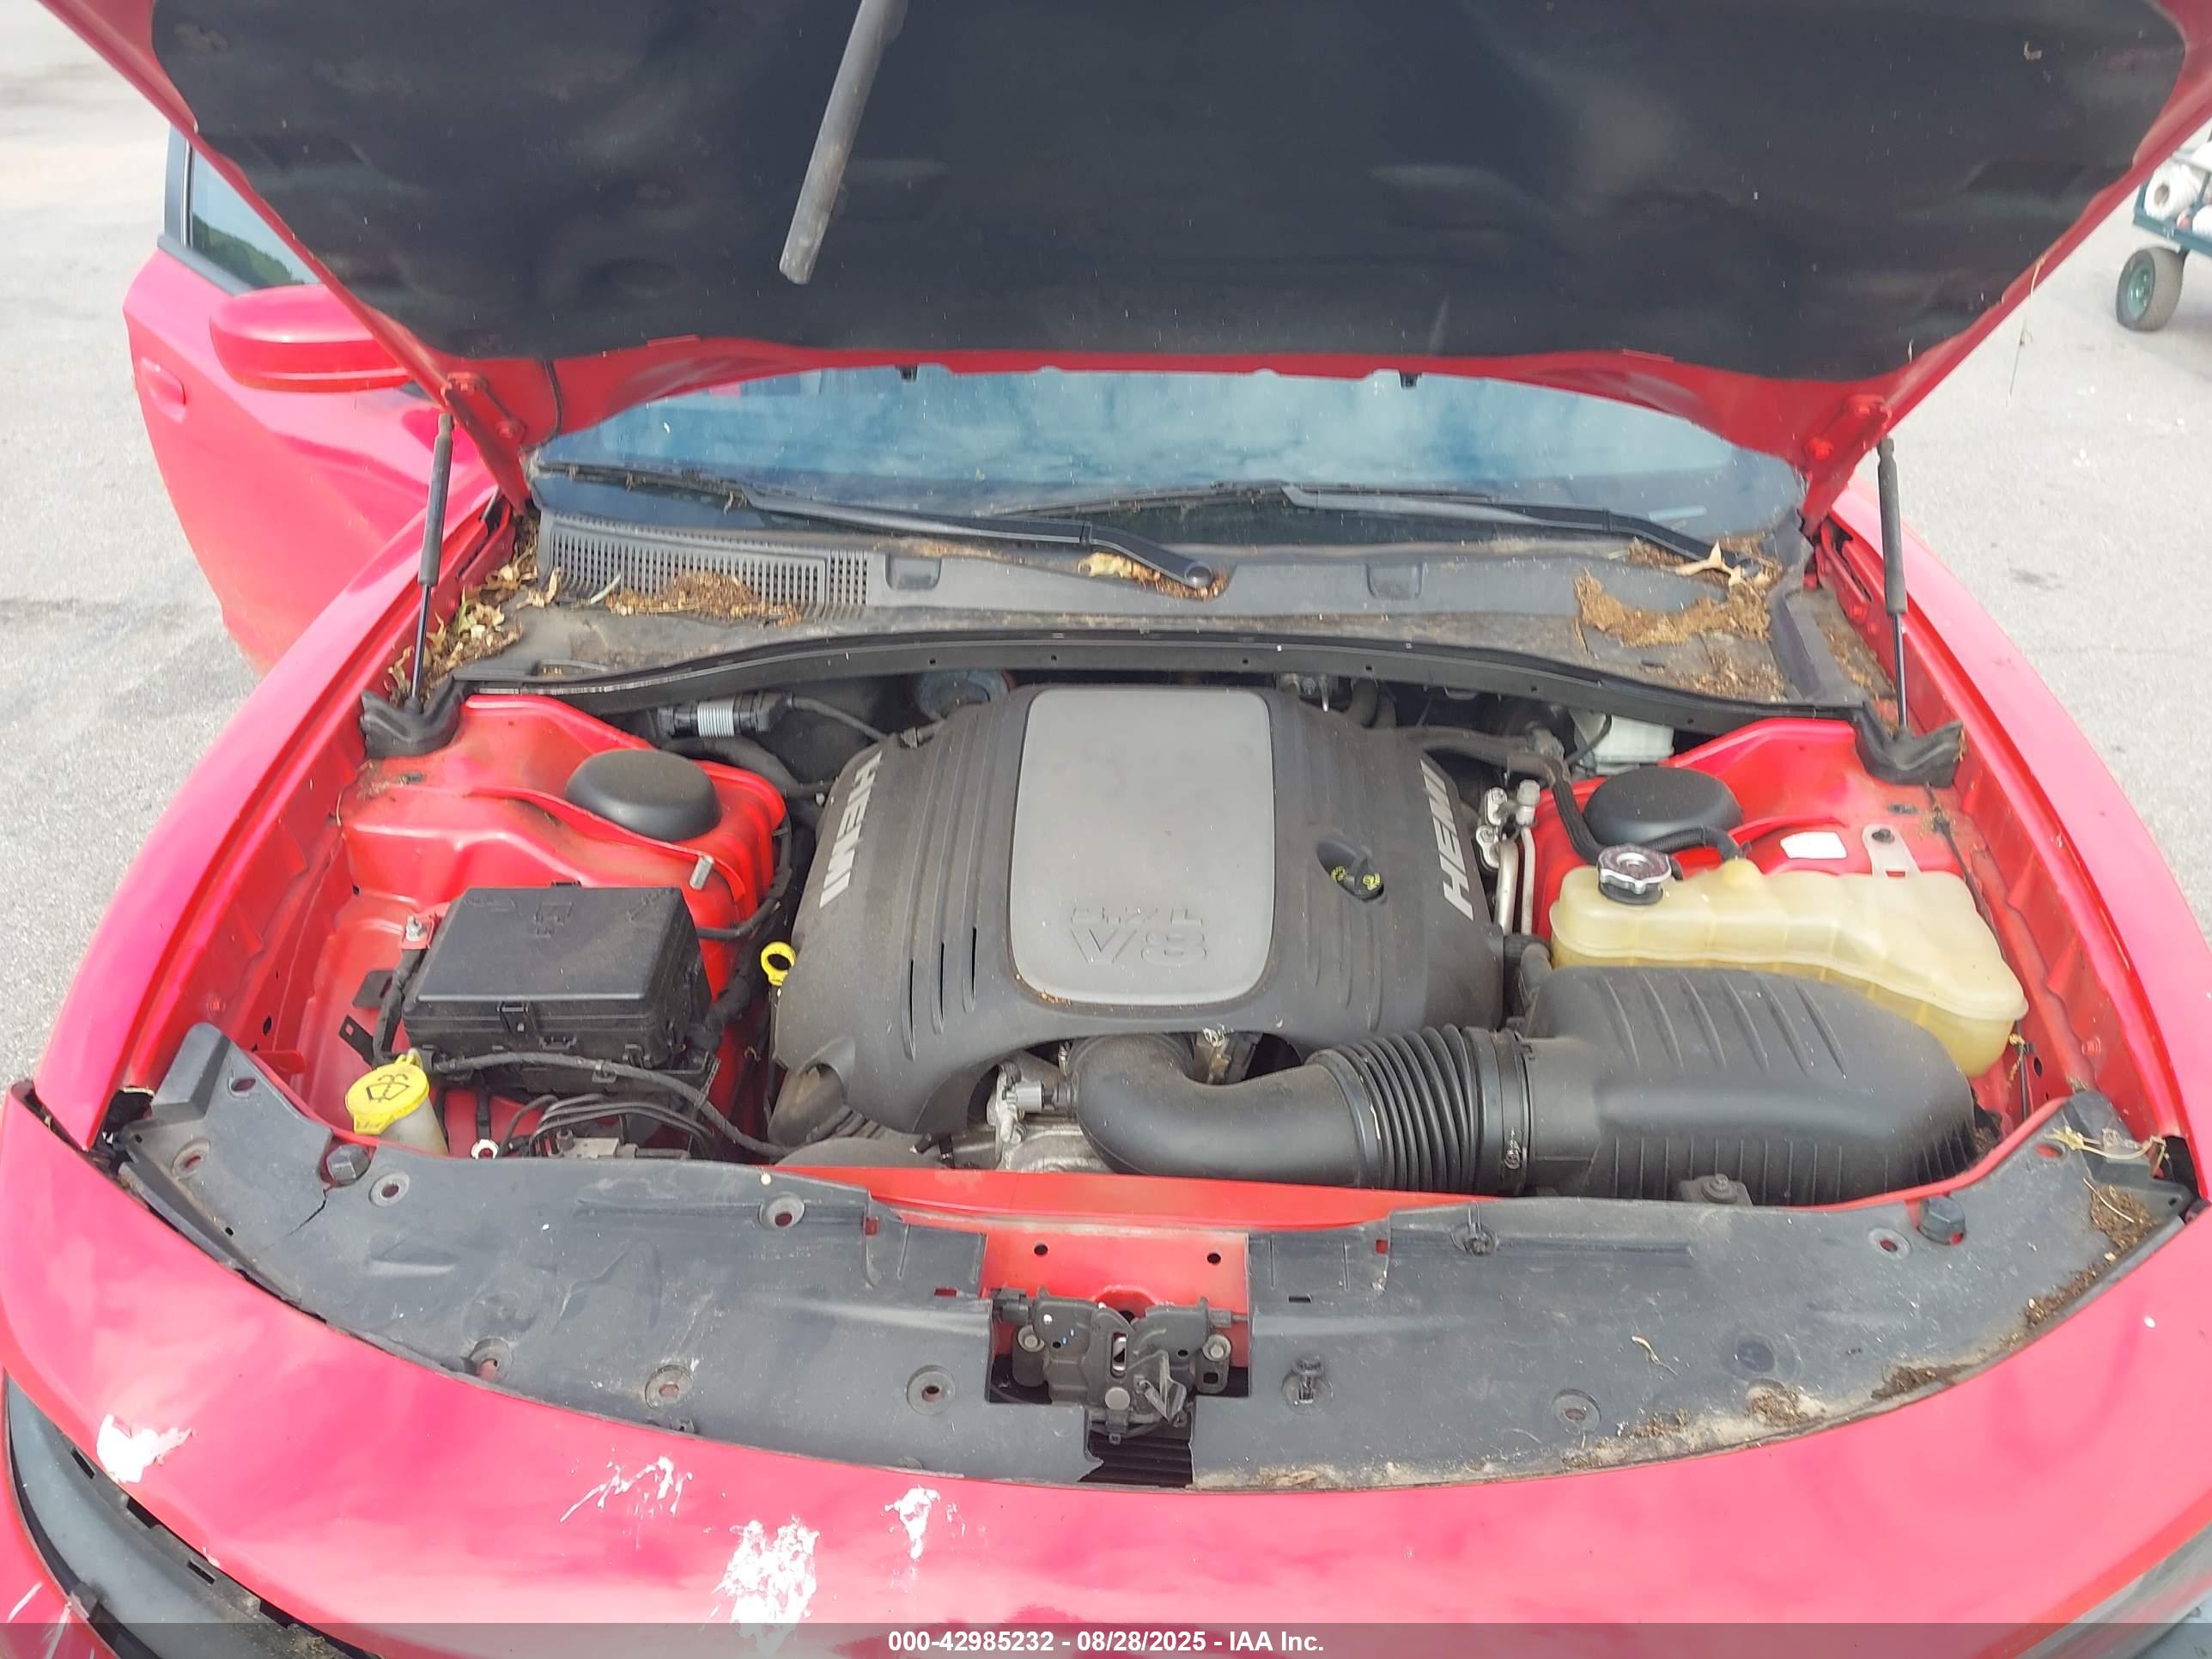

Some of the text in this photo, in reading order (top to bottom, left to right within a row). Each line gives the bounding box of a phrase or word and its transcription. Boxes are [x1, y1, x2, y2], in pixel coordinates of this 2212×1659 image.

[818, 750, 883, 908] HEMI
[1419, 758, 1474, 921] HEMI
[1069, 927, 1207, 967] V8
